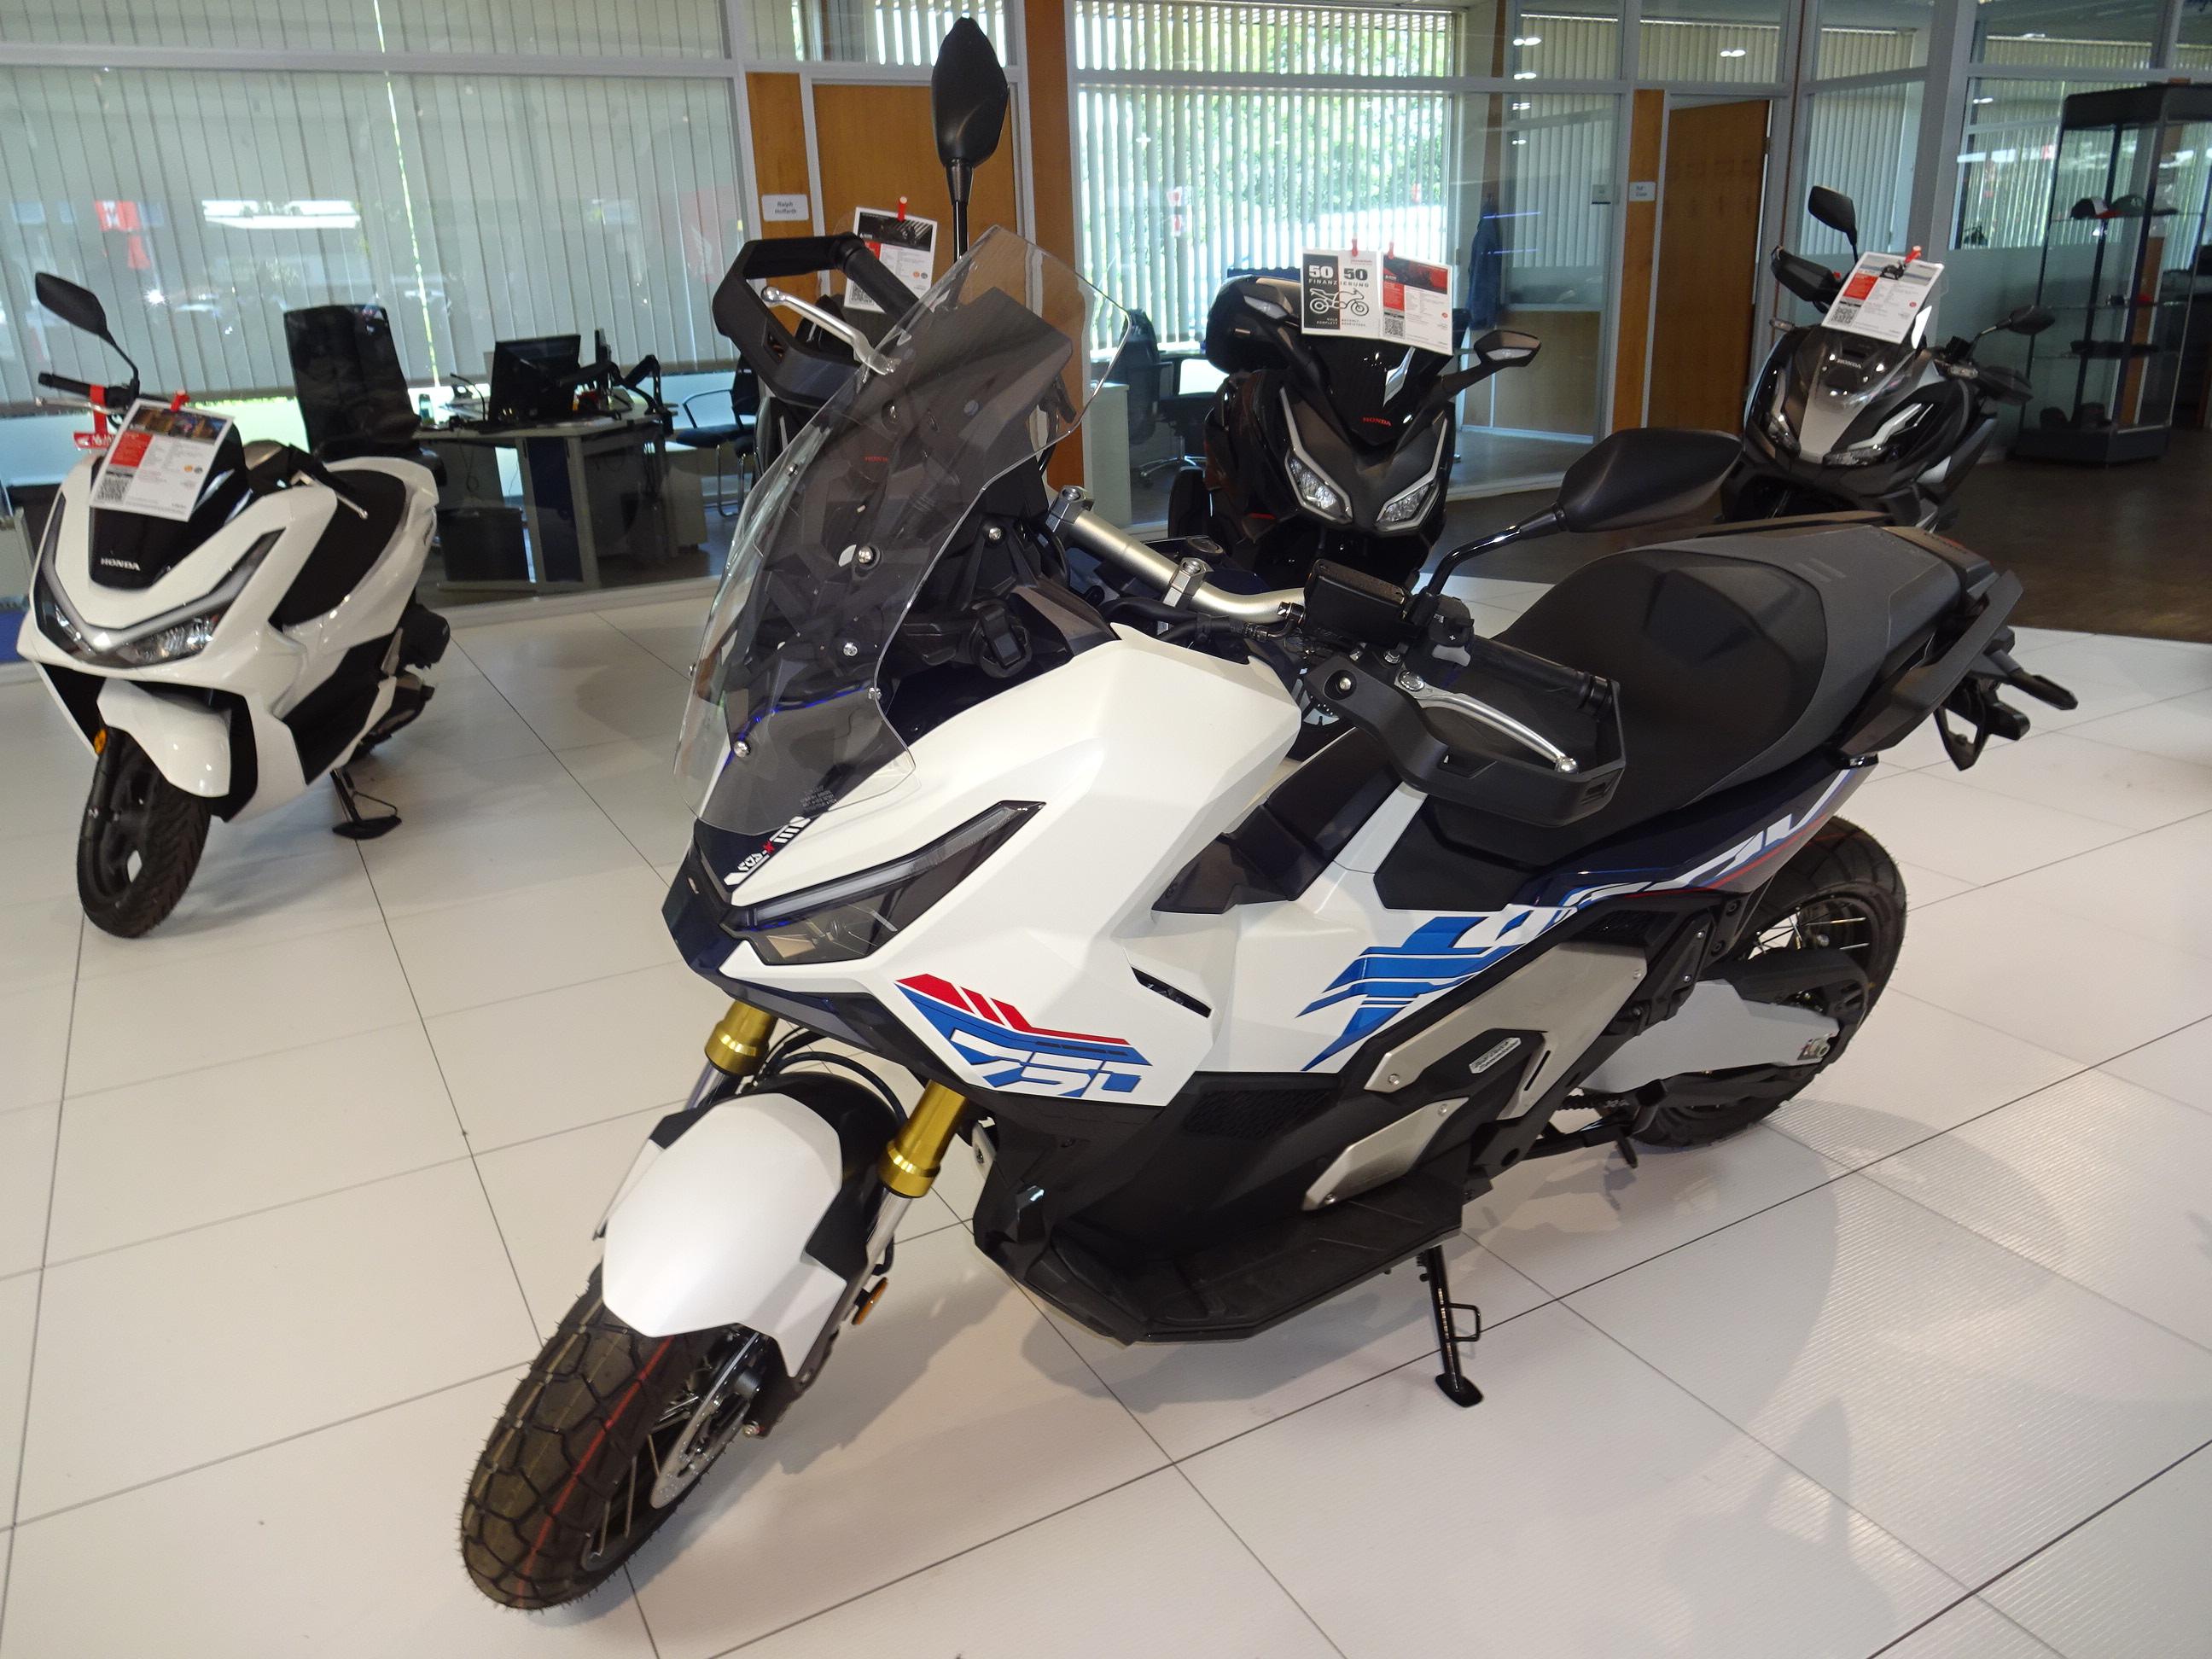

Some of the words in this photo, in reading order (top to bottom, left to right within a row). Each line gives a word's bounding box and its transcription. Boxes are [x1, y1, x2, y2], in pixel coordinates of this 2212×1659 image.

[1308, 265, 1333, 278] 50
[1344, 268, 1367, 280] 50
[1837, 358, 1862, 370] HONDA
[1362, 417, 1392, 426] HONDA
[101, 557, 141, 571] HONDA
